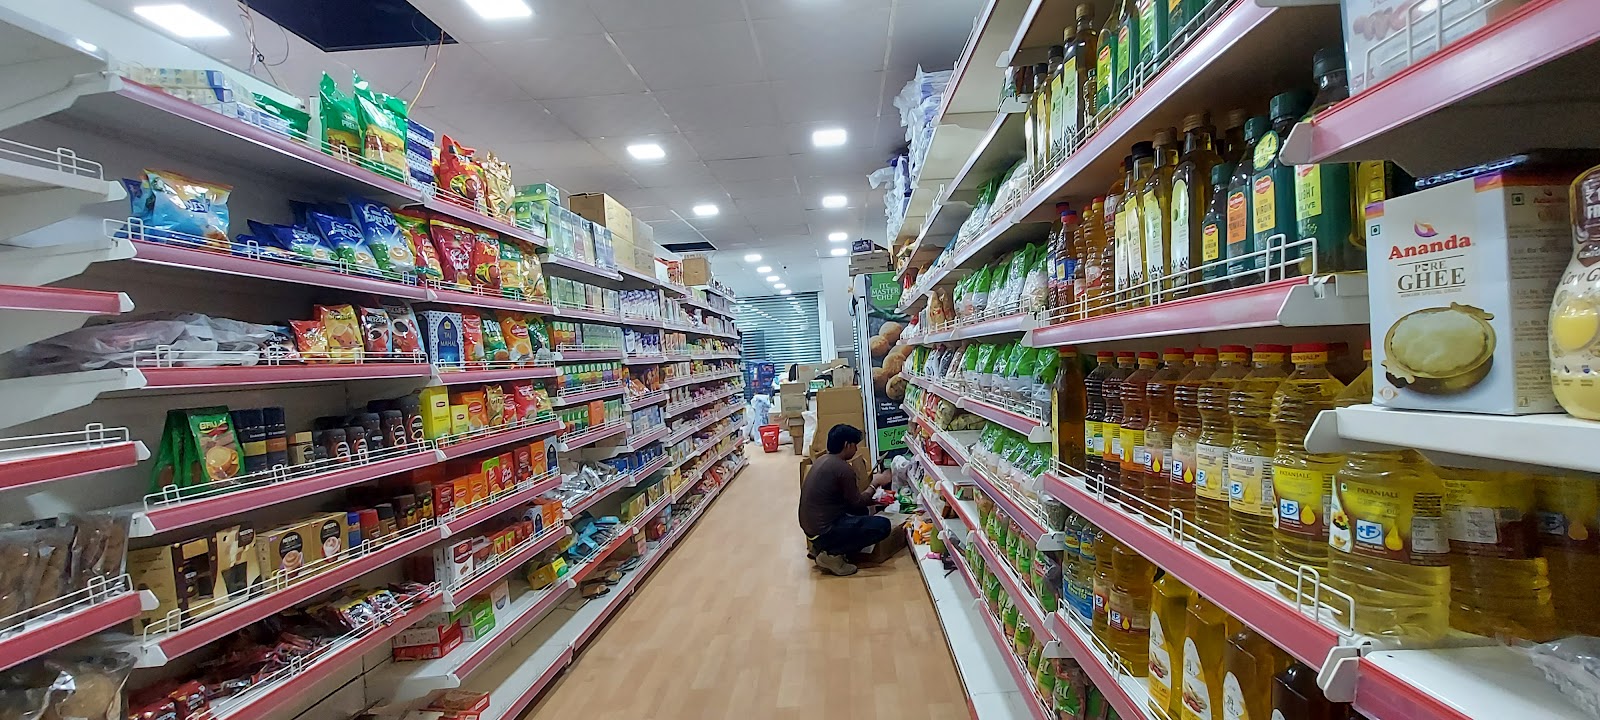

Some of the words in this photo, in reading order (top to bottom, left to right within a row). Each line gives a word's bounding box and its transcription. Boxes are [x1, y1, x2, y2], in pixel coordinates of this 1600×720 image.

[1388, 235, 1471, 260] Ananda
[1414, 261, 1447, 273] PURE
[1397, 267, 1466, 291] GHEE
[871, 287, 899, 296] MASTER
[1279, 470, 1311, 479] PATANJALI
[1357, 487, 1399, 499] PATANJALI
